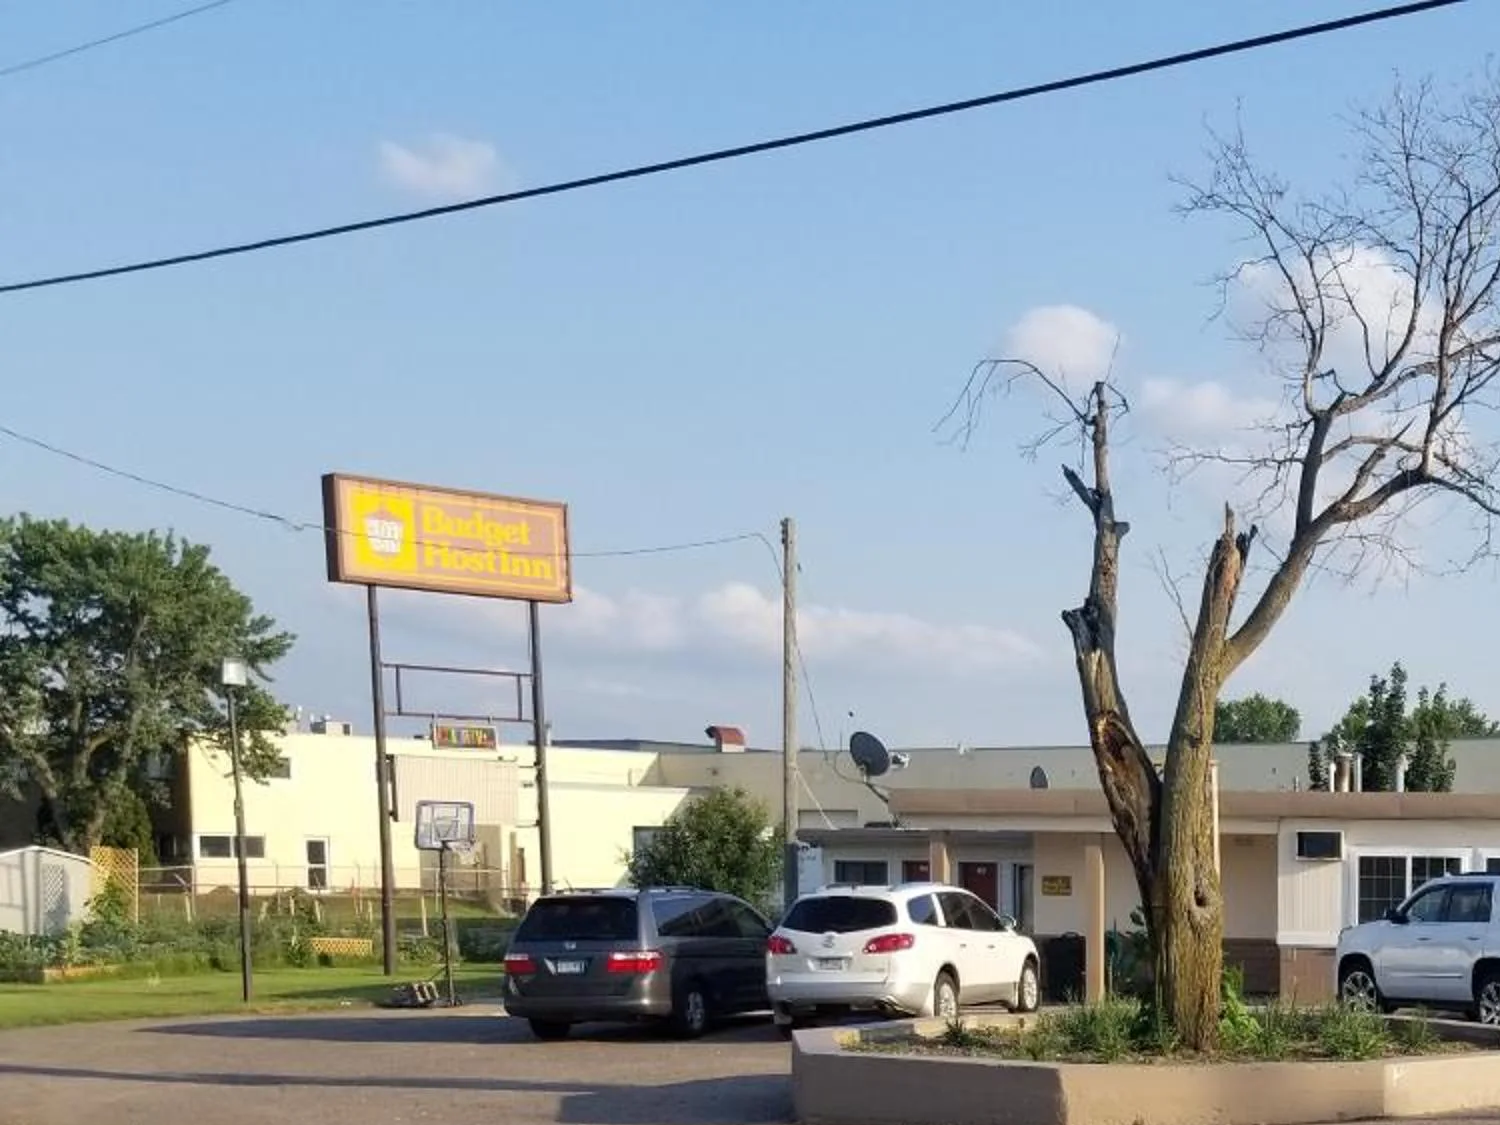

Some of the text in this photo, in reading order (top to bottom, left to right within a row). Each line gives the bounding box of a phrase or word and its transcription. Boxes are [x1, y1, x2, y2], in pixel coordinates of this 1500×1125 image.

[422, 504, 531, 547] Budget
[423, 539, 553, 579] Host Inn
